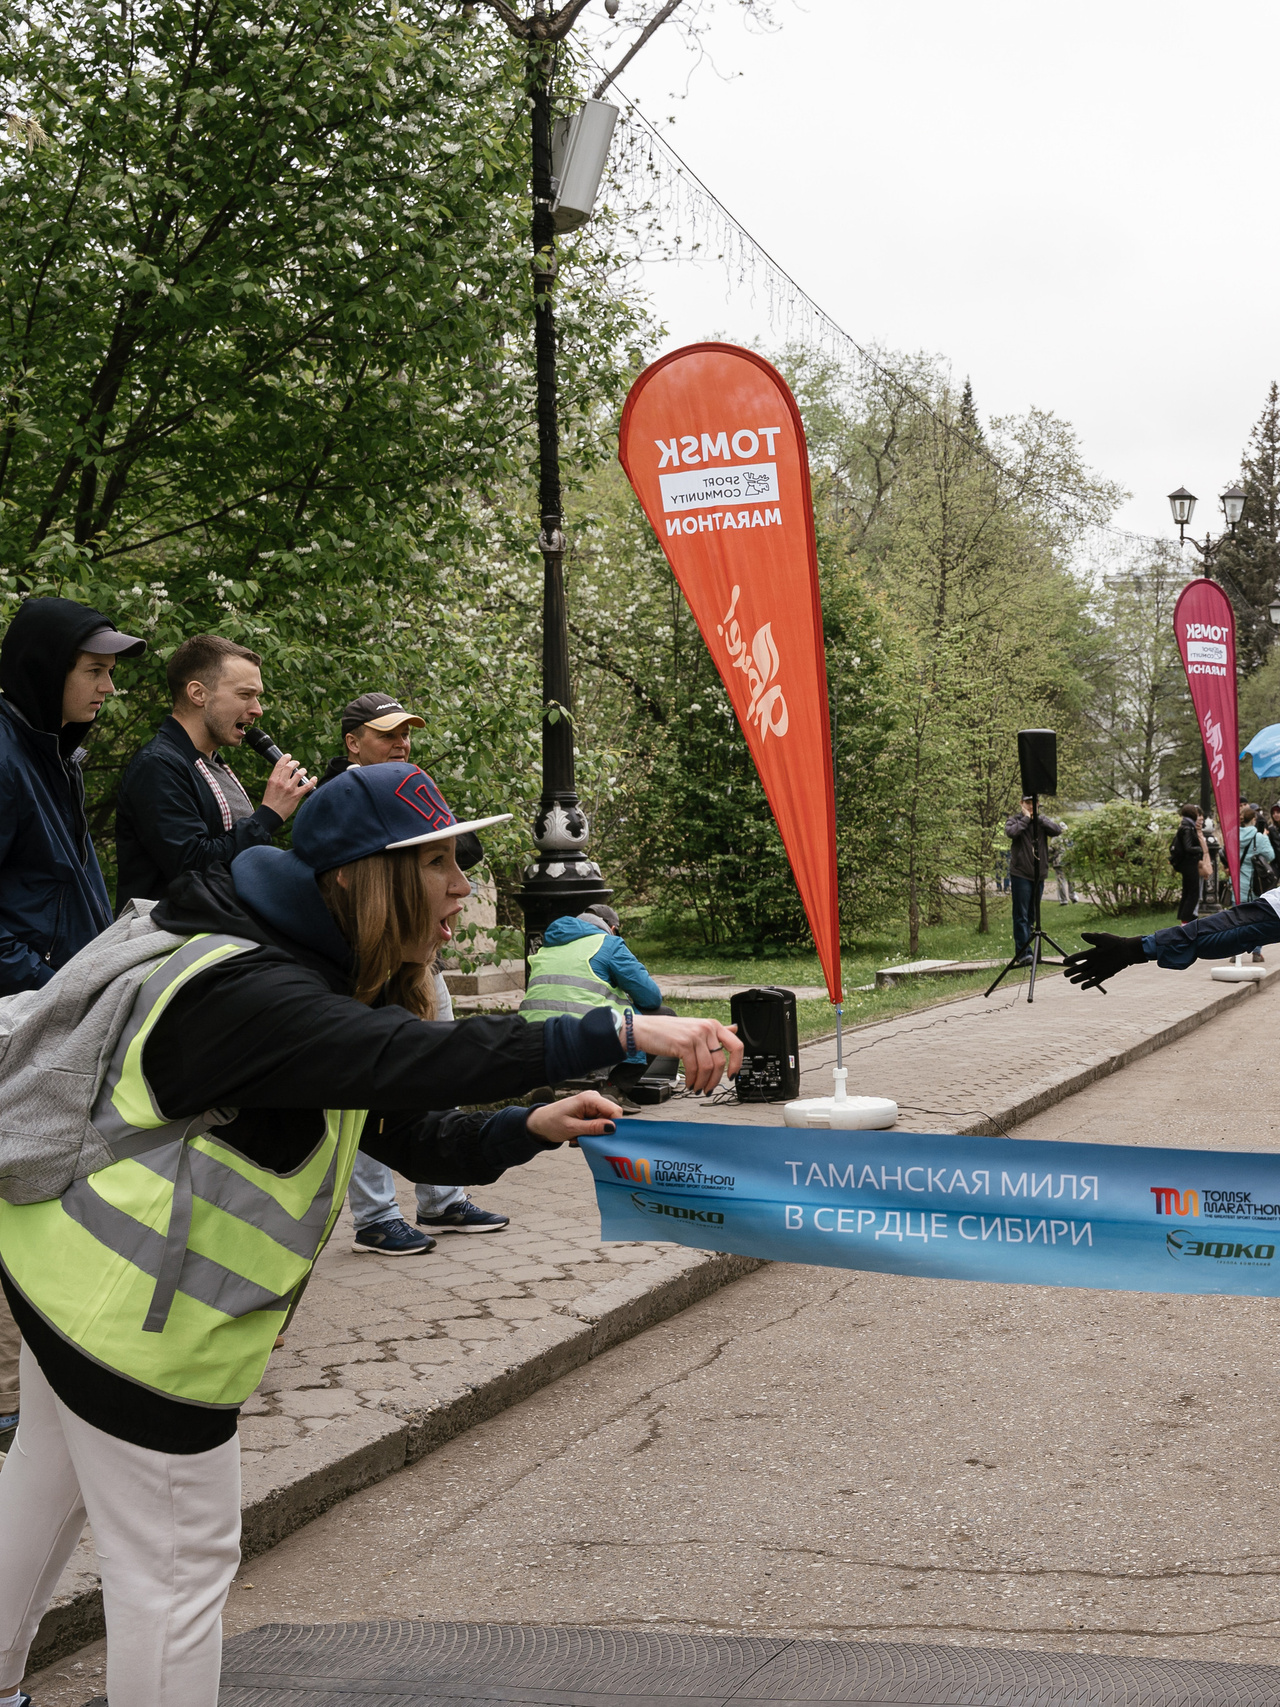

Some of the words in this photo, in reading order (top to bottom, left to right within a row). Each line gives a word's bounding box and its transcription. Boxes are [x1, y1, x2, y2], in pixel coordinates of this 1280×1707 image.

[654, 1159, 703, 1173] TOMSK
[655, 1171, 735, 1186] MARATHON
[785, 1161, 990, 1195] ТАМАНСКАЯ
[1001, 1171, 1099, 1201] МИЛЯ
[1202, 1190, 1251, 1203] TOMSK
[648, 1202, 725, 1225] ЭФКО
[785, 1205, 804, 1230] В
[813, 1208, 948, 1243] СЕРДЦЕ
[958, 1215, 1093, 1247] СИБИРИ
[1184, 1240, 1276, 1259] ЭФКО
